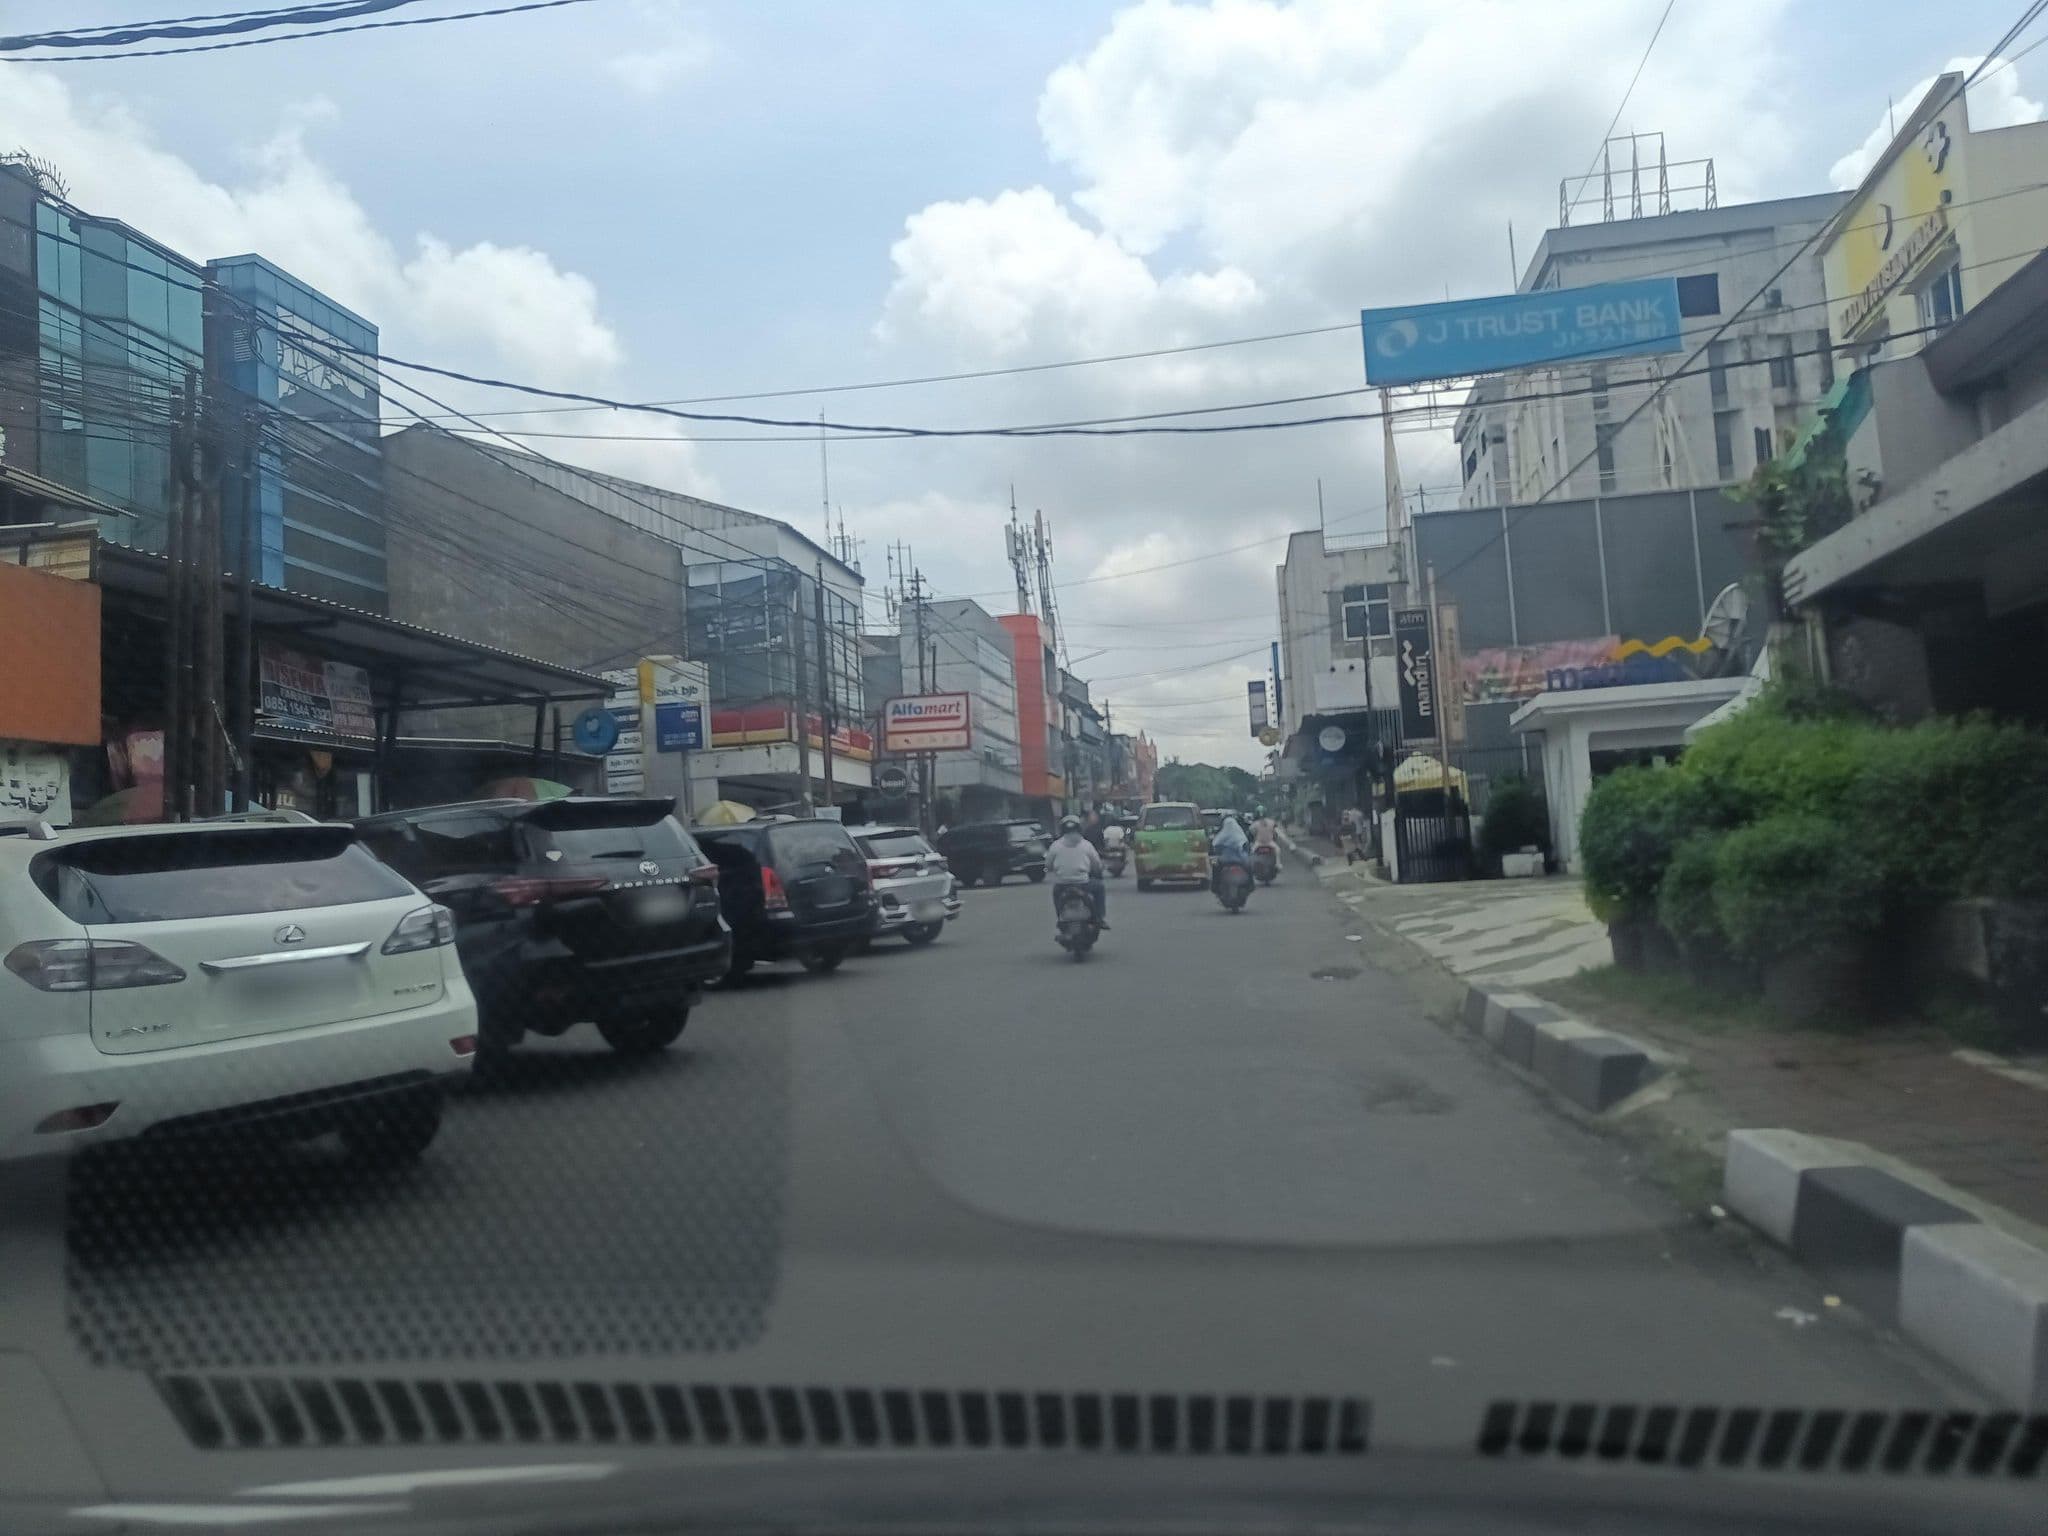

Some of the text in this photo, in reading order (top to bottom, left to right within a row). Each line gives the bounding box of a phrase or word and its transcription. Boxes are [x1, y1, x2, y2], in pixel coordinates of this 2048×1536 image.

[1429, 298, 1663, 344] J TRUST BANK
[681, 685, 699, 697] bjb
[1414, 655, 1432, 716] mandiri
[892, 701, 961, 716] Alfamart
